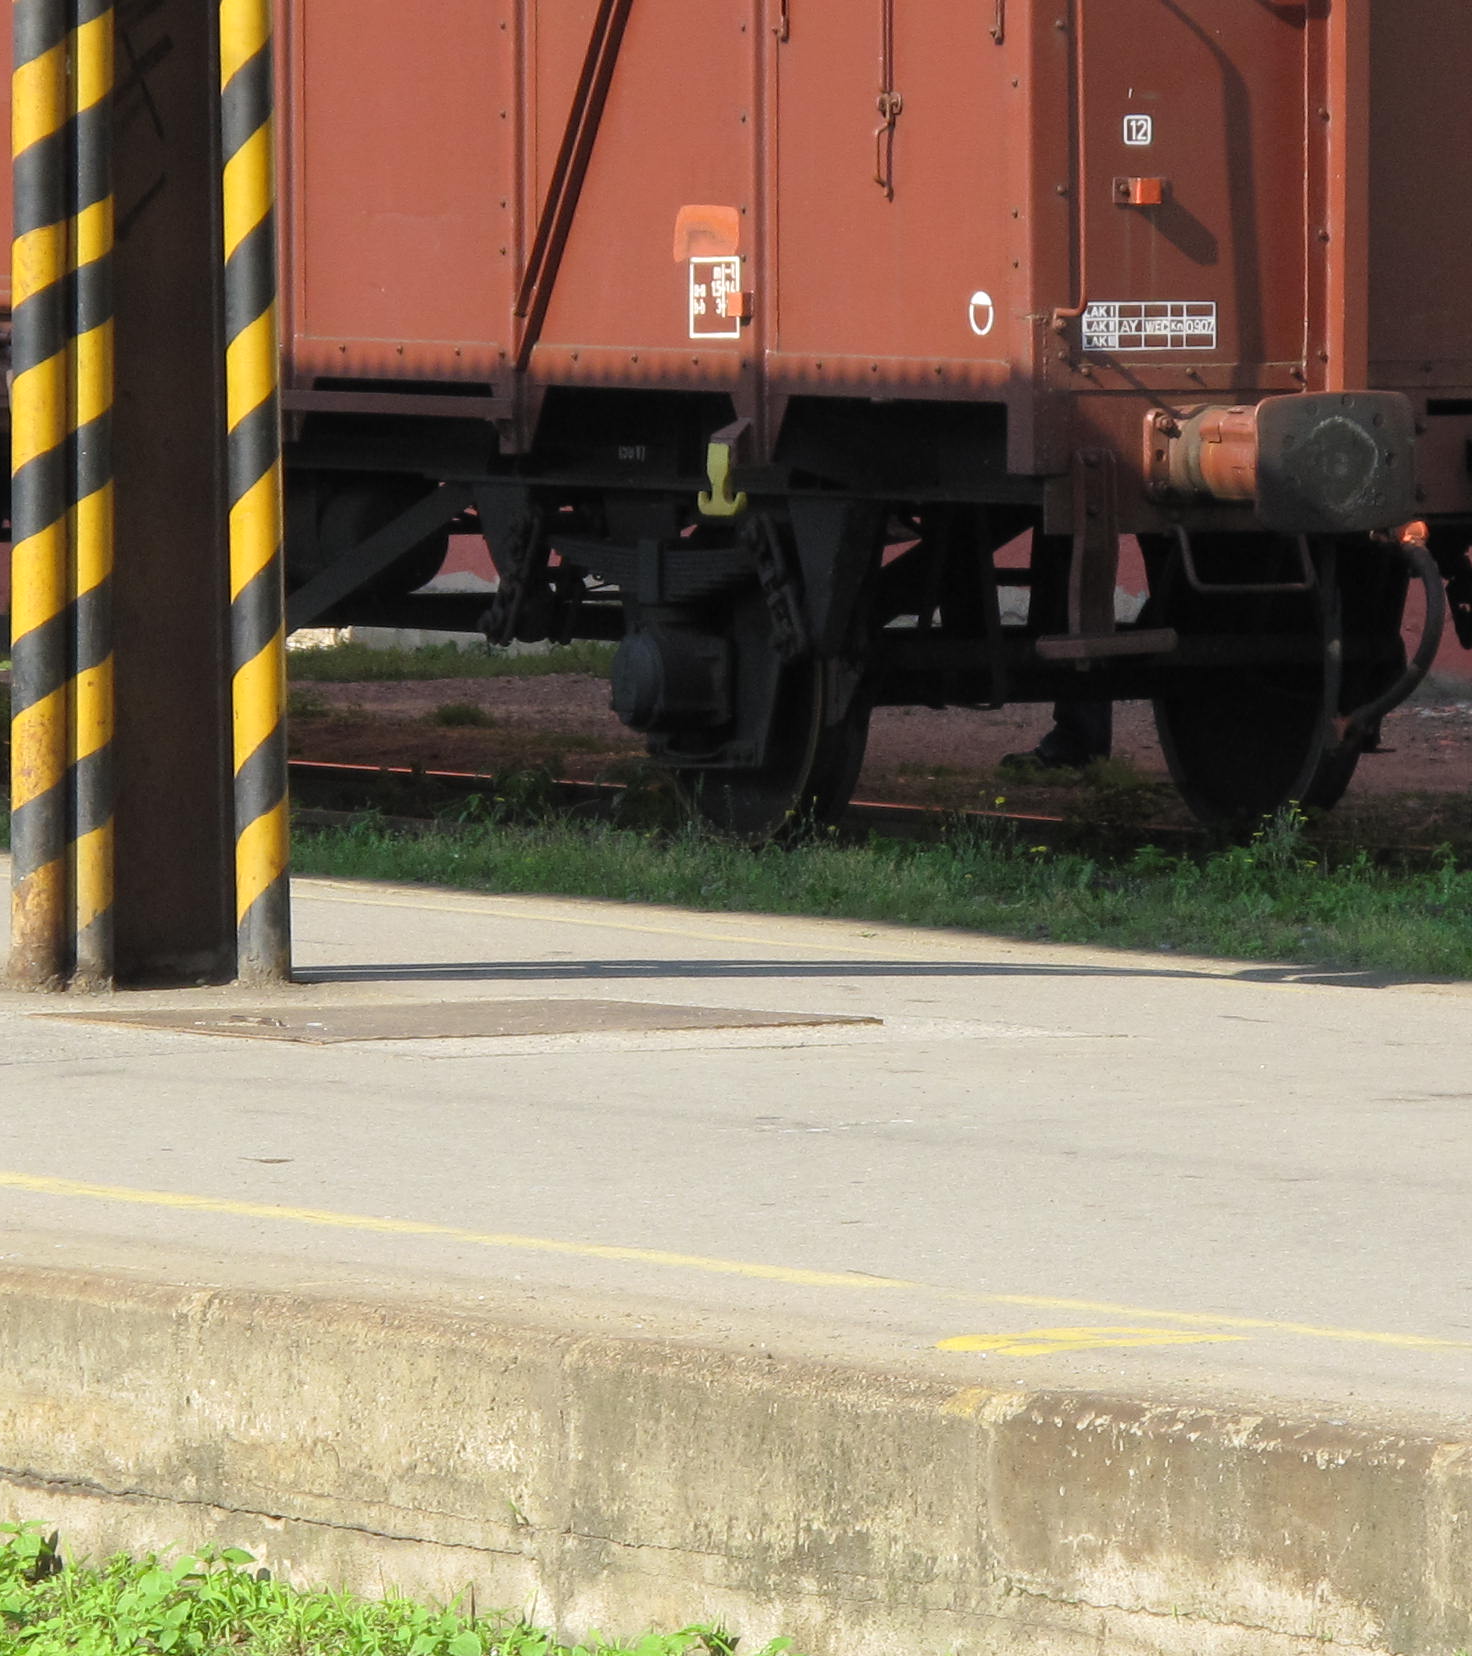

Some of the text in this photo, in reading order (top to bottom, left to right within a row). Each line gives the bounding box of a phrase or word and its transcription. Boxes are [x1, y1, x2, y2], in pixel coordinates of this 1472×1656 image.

[1129, 120, 1147, 141] 12
[1085, 321, 1107, 333] LAK
[1121, 321, 1139, 333] AY
